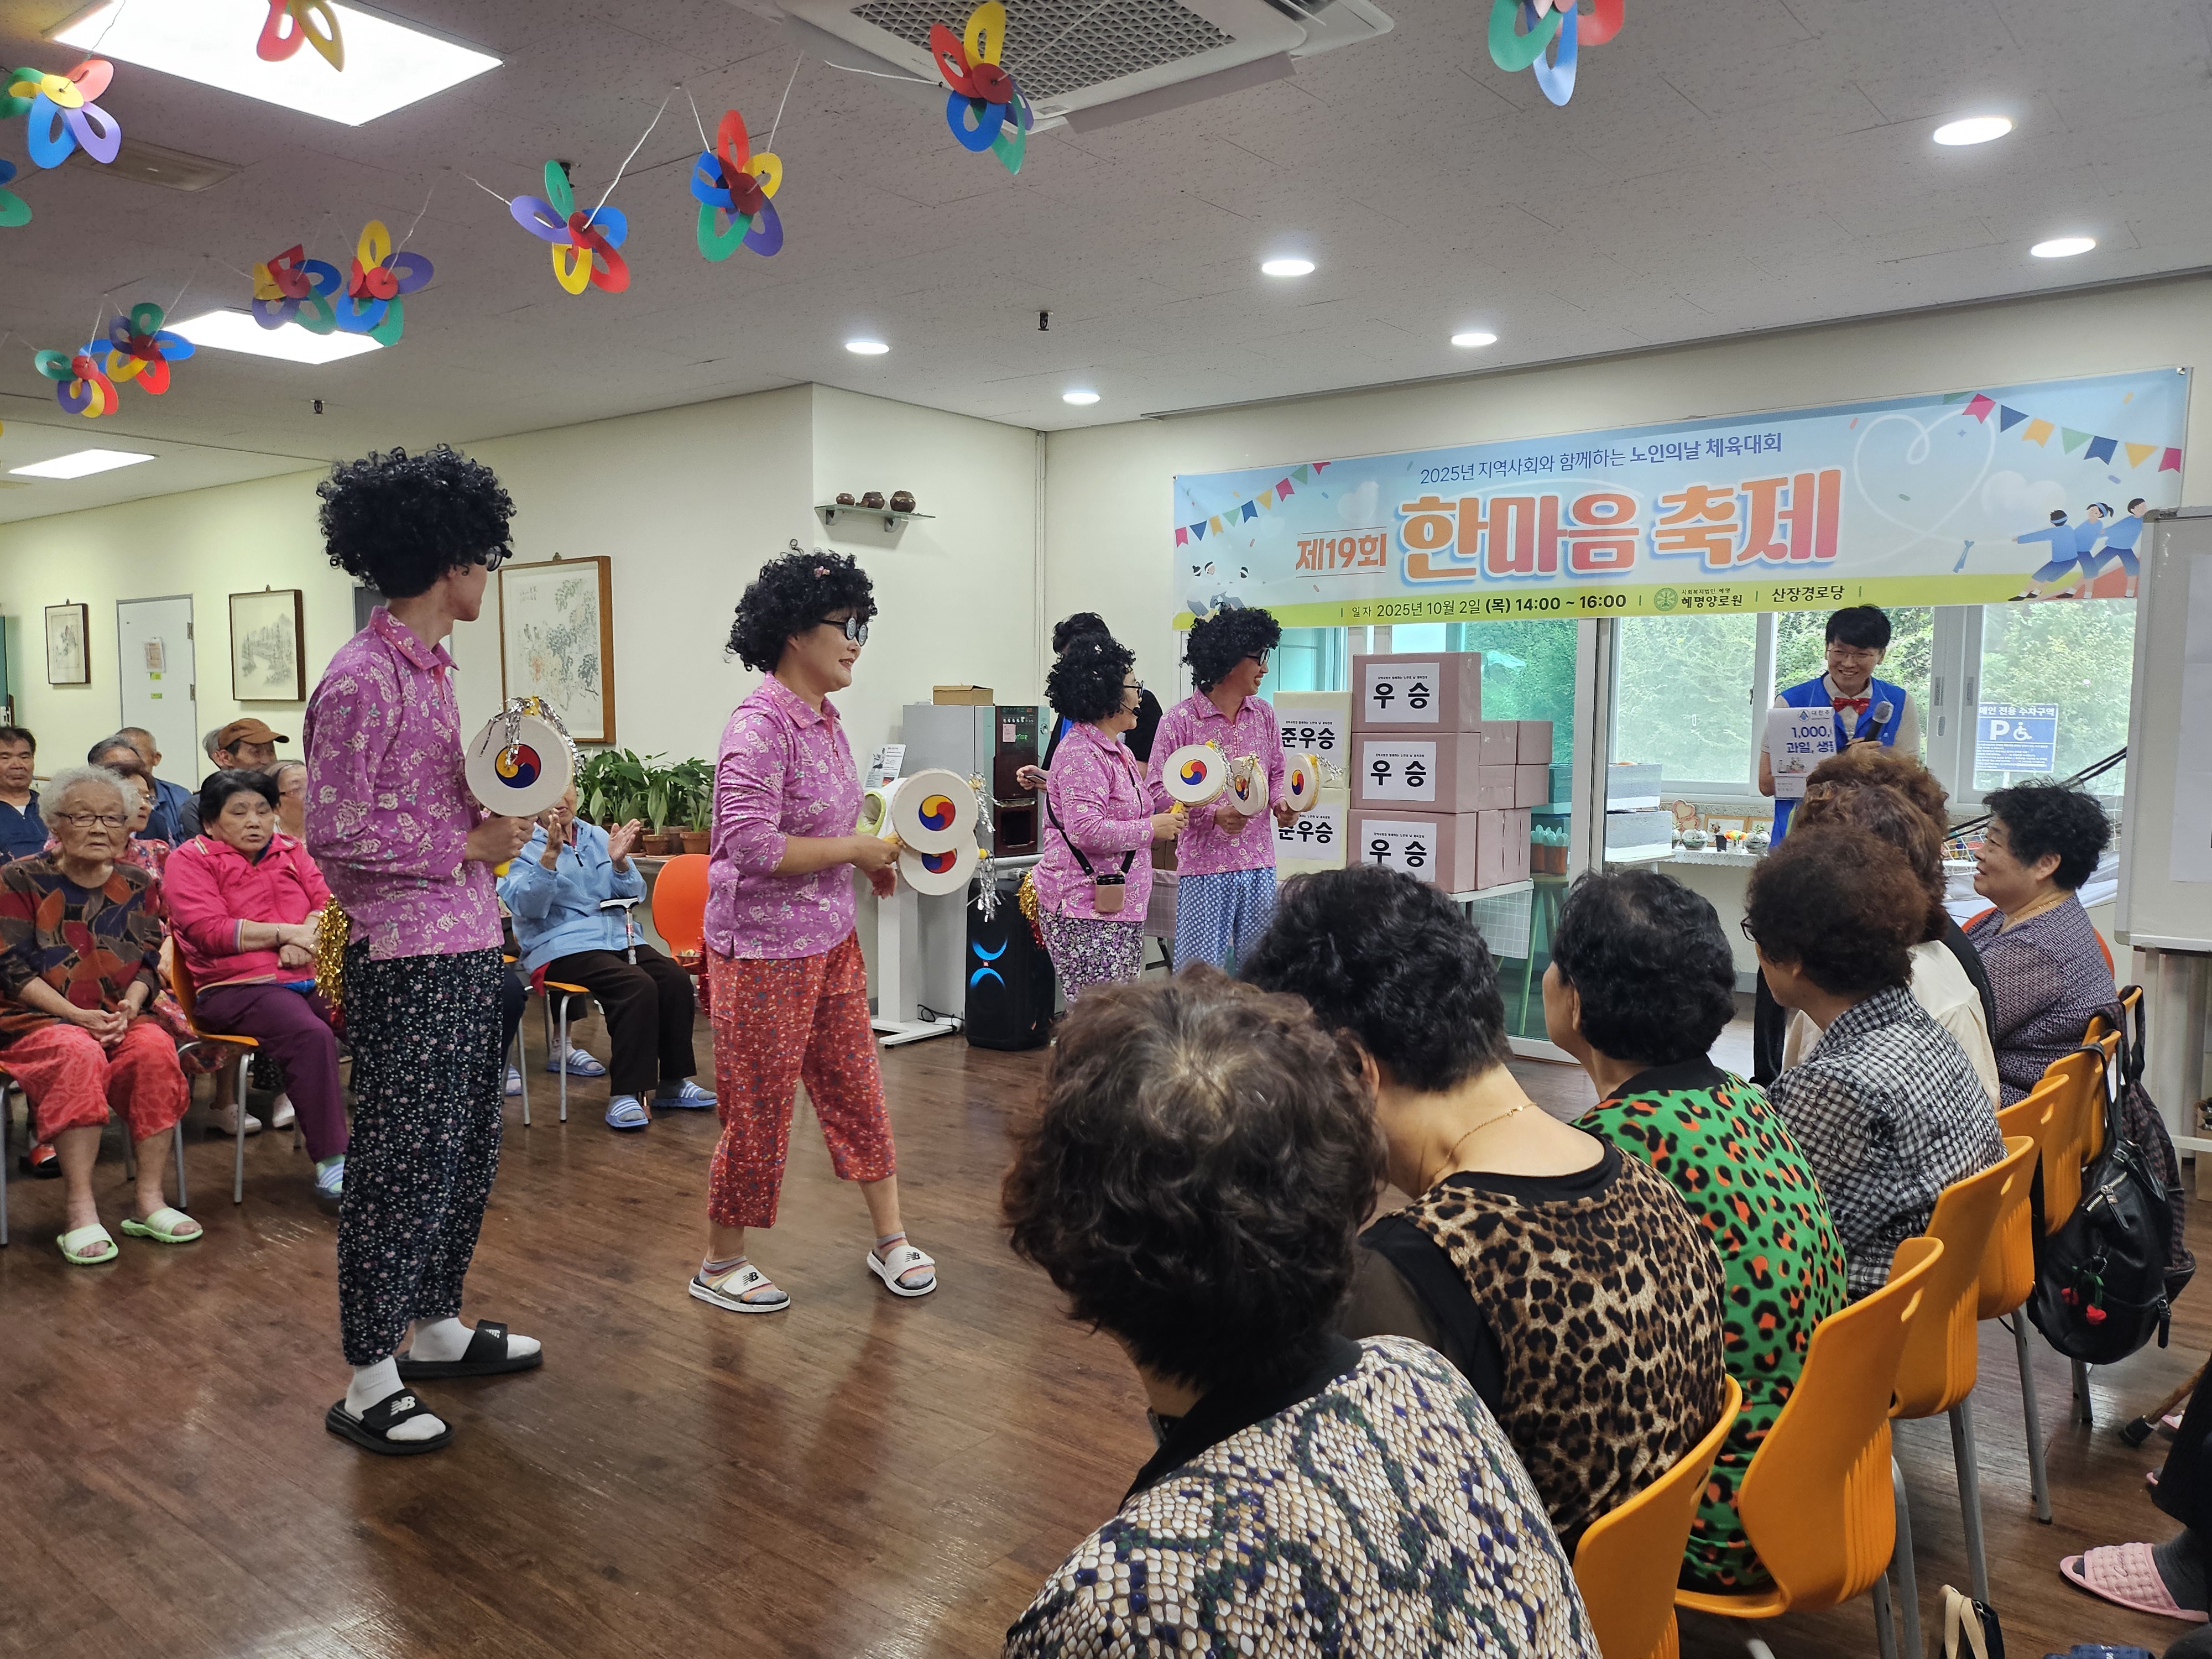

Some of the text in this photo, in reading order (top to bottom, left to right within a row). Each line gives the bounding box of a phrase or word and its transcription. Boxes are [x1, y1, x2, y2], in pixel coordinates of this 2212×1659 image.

[1421, 432, 1782, 484] 2025년 지역사회와 함께하는 노인의날 체육대회
[1401, 469, 1841, 580] 한마음 축제
[1296, 533, 1387, 571] 제19회
[1681, 594, 1743, 608] 혜명양로원
[1771, 586, 1845, 602] 산장경로당
[1377, 601, 1422, 617] 2025년
[1427, 600, 1454, 615] 10월
[1459, 599, 1480, 614] 2일
[1486, 598, 1510, 613] (목)
[1516, 597, 1561, 612] 14:00
[1579, 594, 1626, 609] 16:00
[1999, 706, 2017, 716] 전용
[2019, 707, 2055, 716] 주차구역
[1281, 727, 1335, 750] 준우승
[1791, 726, 1832, 738] 1,000,
[1990, 719, 2010, 740] P
